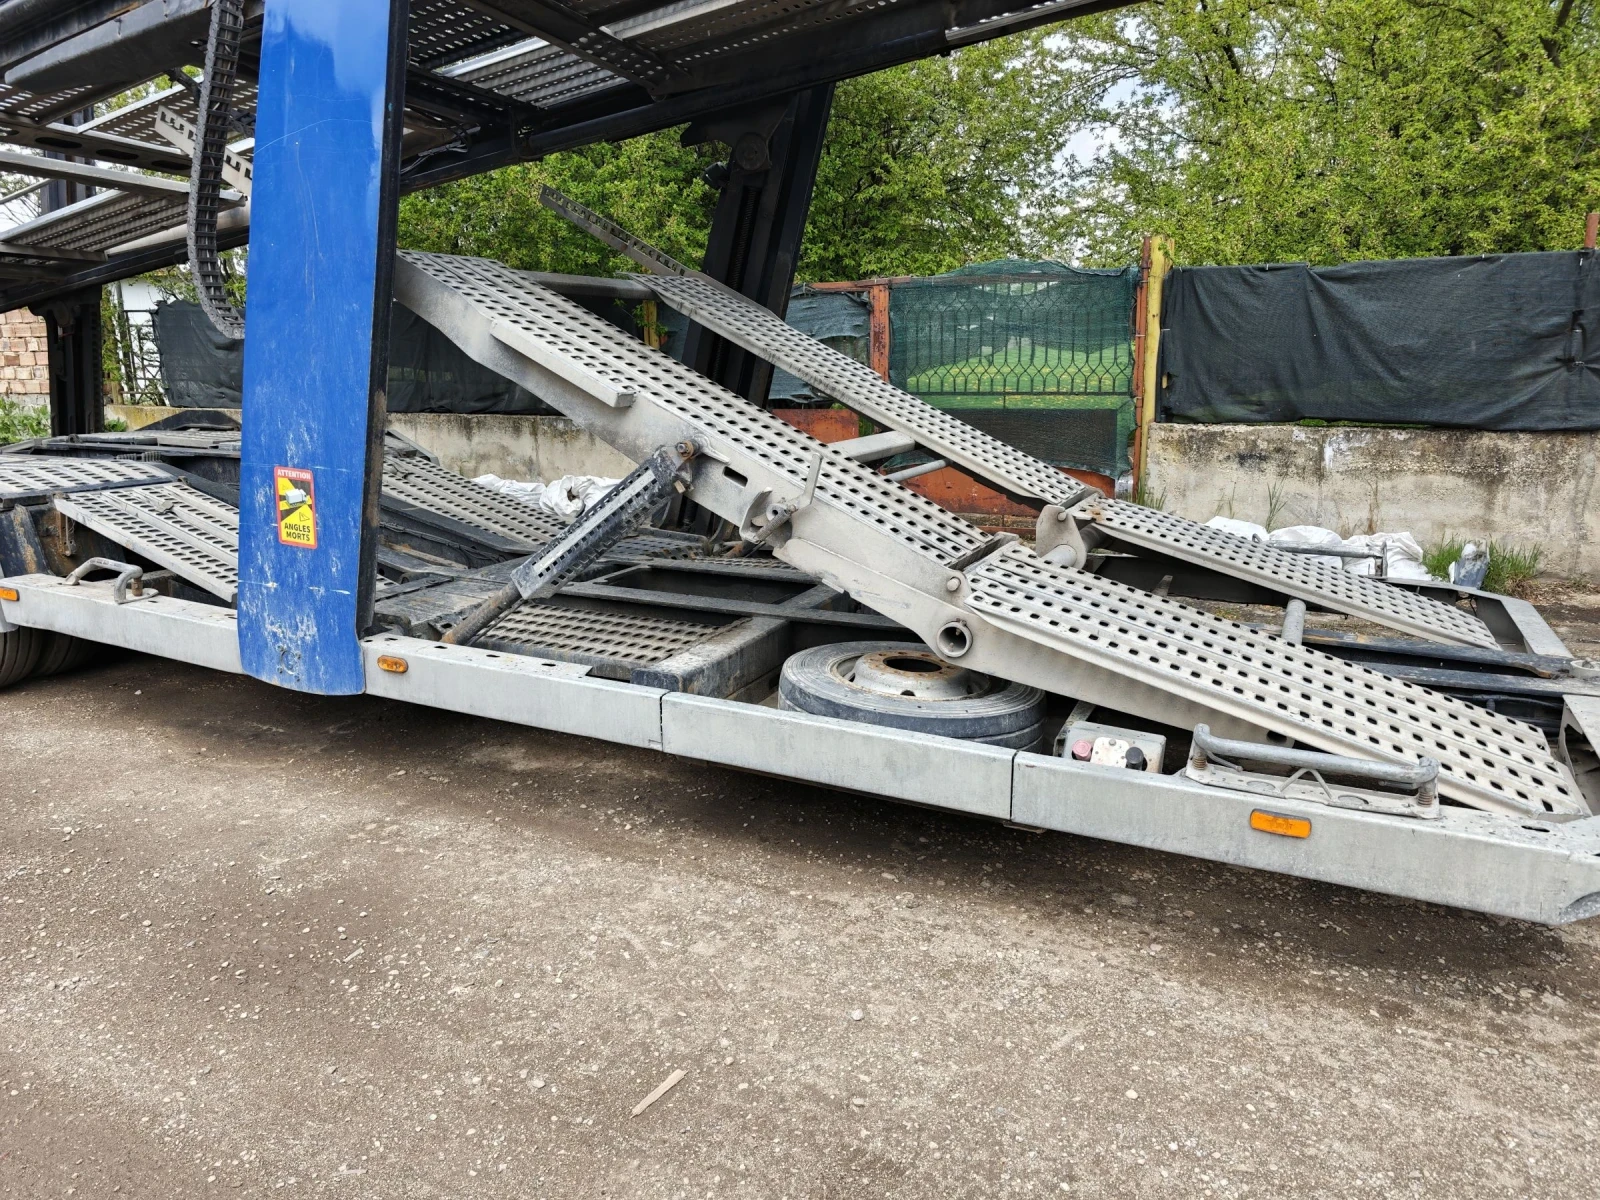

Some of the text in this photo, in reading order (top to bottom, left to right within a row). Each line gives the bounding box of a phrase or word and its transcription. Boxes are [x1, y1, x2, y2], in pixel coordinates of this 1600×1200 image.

[277, 469, 311, 480] ATTENTION
[284, 522, 311, 533] ANGLES
[286, 531, 310, 542] MORTS
